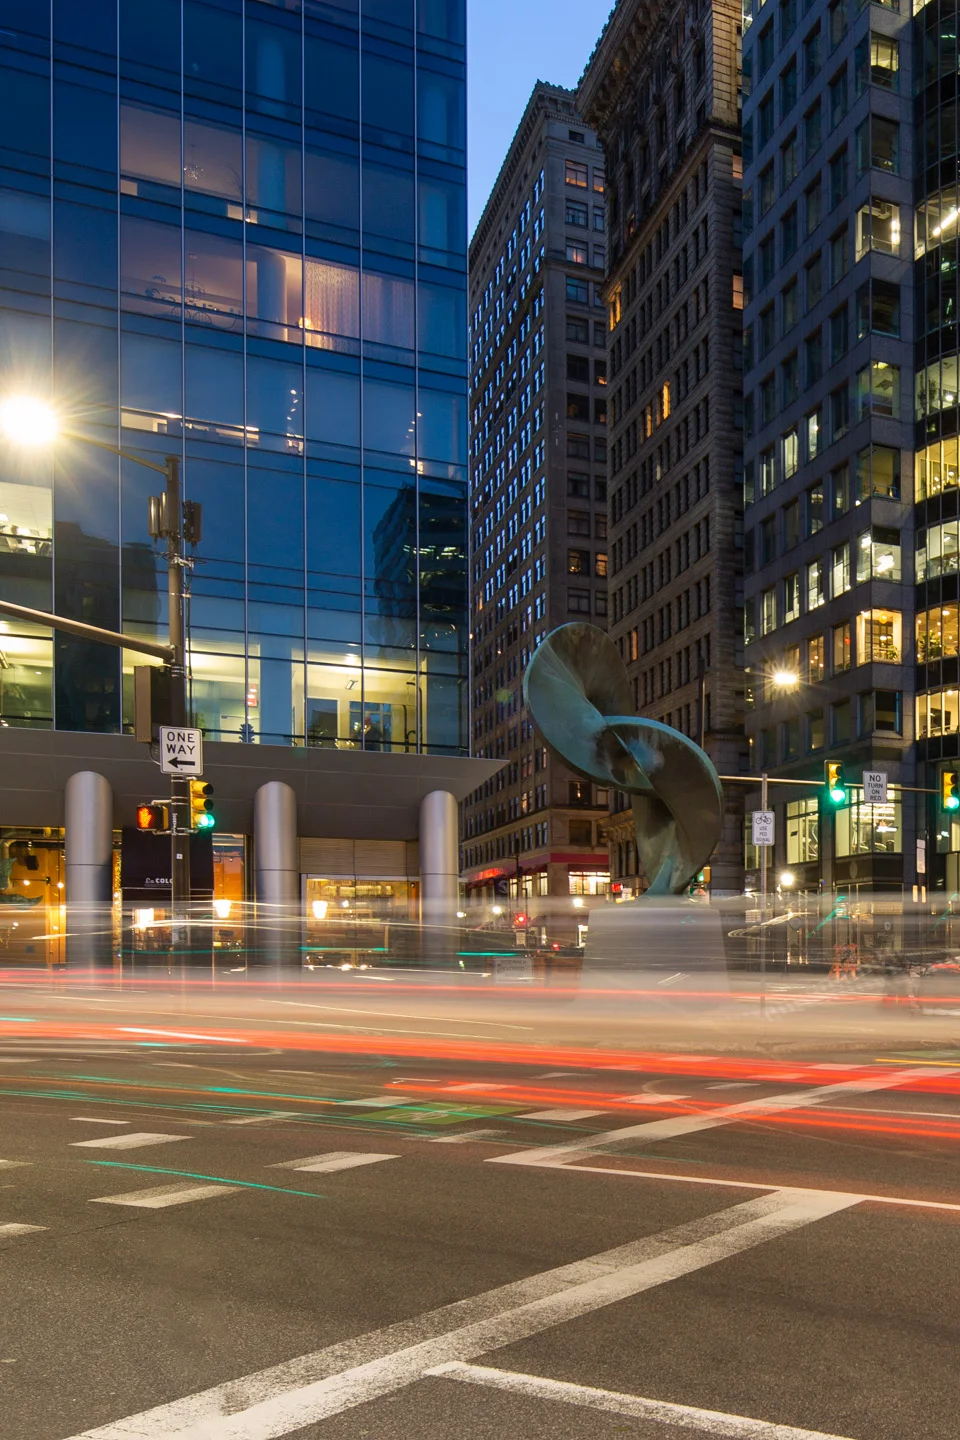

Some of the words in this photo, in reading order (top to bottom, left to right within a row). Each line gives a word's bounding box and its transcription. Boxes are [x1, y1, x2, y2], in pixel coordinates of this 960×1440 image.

[167, 731, 195, 743] ONE
[166, 743, 196, 755] WAY
[869, 774, 882, 782] NO
